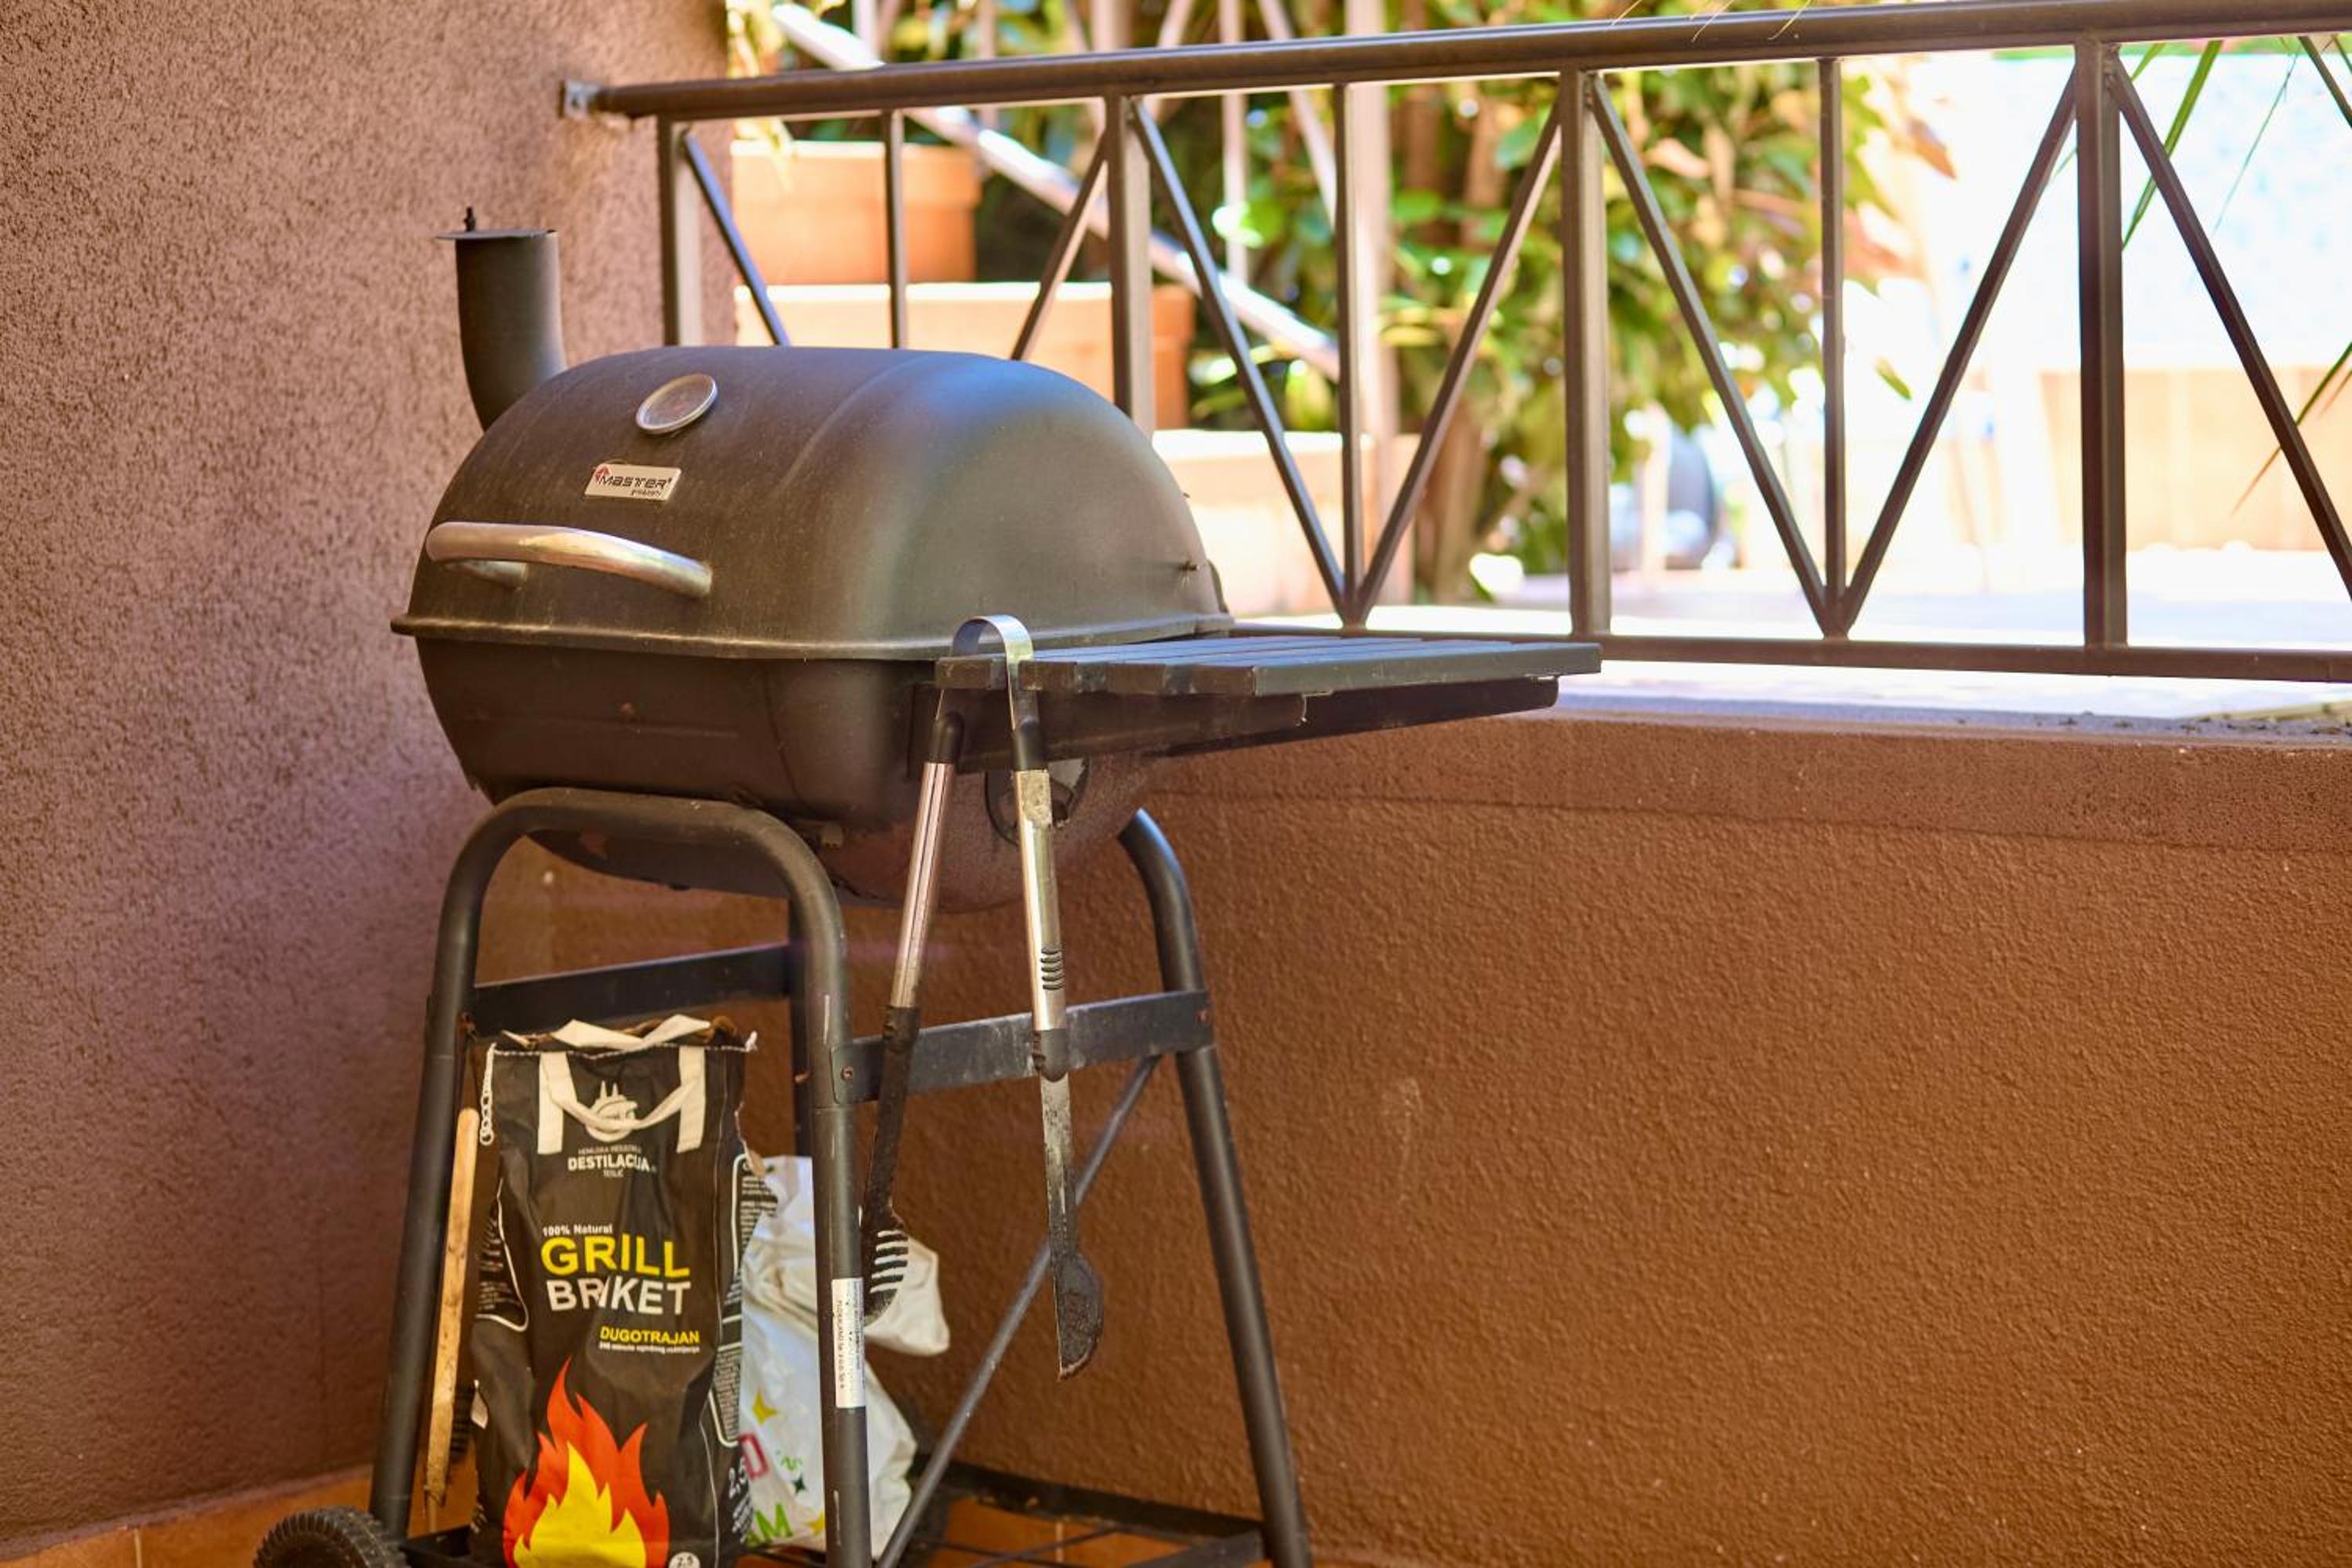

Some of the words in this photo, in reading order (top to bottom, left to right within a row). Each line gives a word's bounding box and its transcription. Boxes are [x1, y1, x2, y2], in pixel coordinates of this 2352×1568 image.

[543, 1225, 570, 1236] 100%
[574, 1224, 612, 1235] Natural
[541, 1232, 690, 1278] GRILL
[601, 1326, 700, 1344] DUGOTRAJAN
